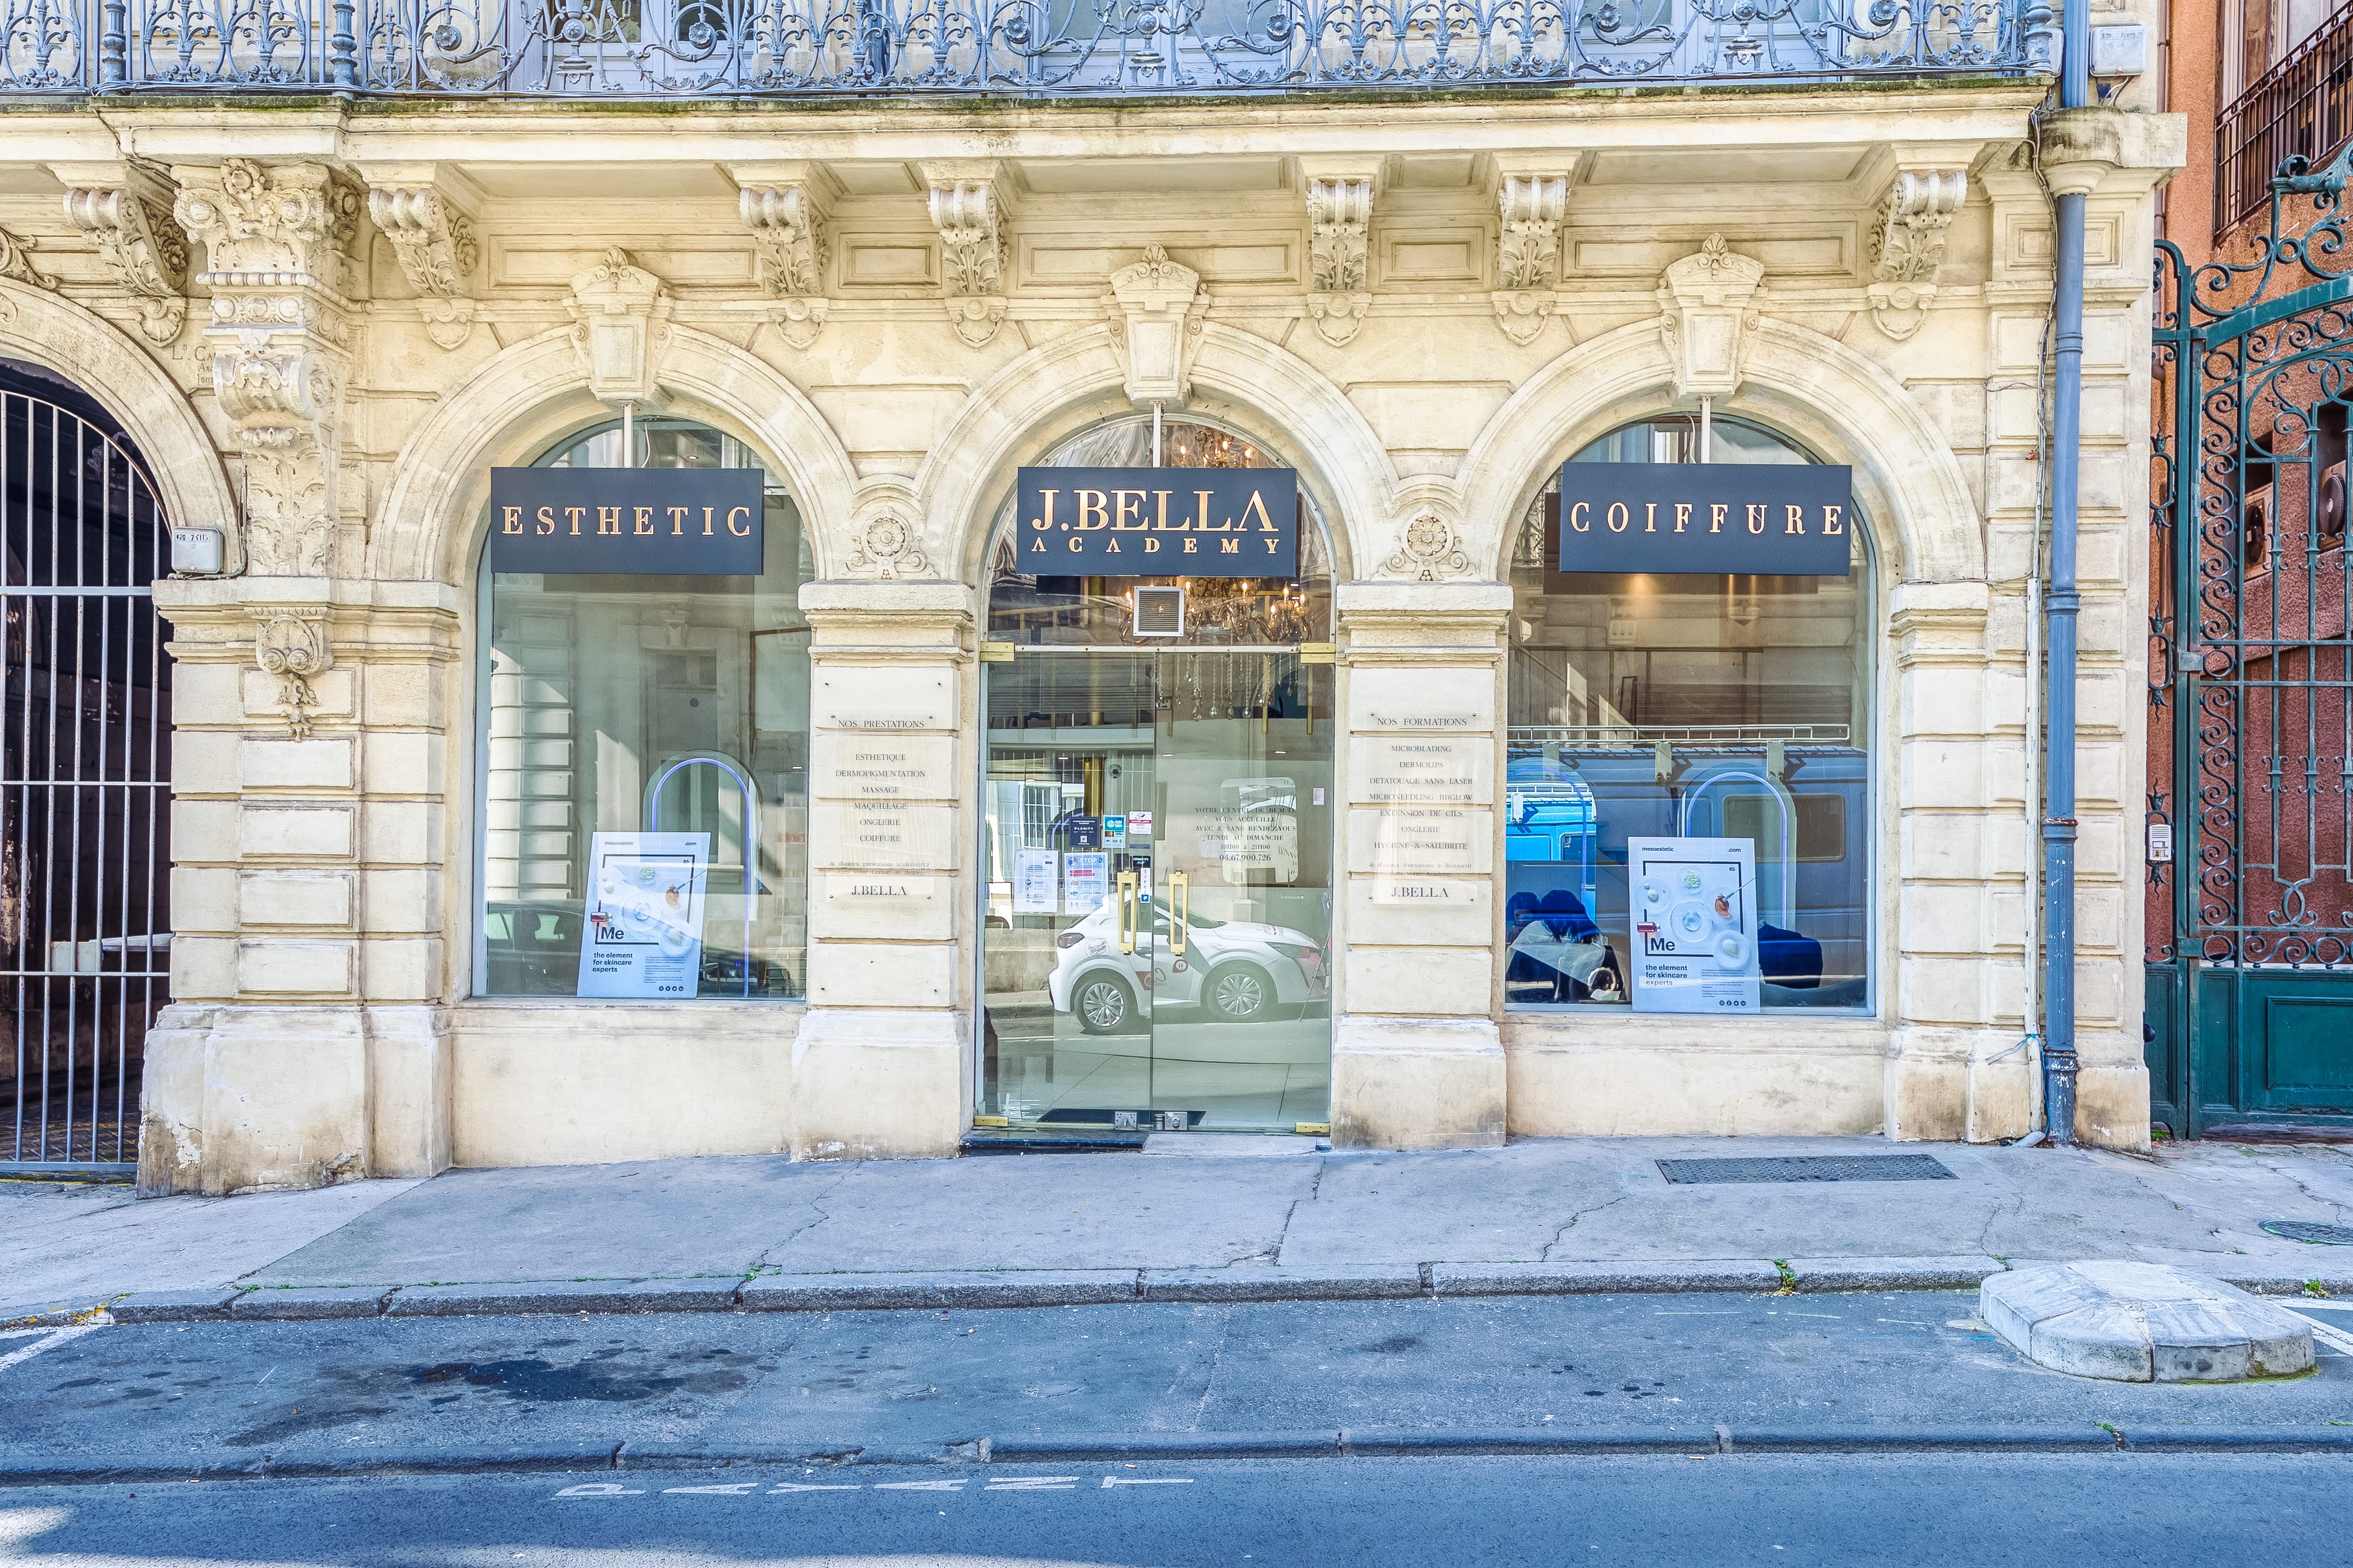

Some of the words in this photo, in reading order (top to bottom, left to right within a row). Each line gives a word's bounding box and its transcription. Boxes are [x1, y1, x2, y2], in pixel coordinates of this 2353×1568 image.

[1032, 489, 1279, 532] J.BELLA
[502, 506, 751, 536] ESTHETIC
[1571, 501, 1843, 535] COIFFURE
[1031, 537, 1279, 554] ACADEMY
[838, 720, 858, 728] NOS
[864, 720, 924, 728] PRESTATIONS
[1378, 718, 1397, 727] NOS
[1403, 718, 1467, 727] FORMATIONS
[854, 803, 907, 811] MAQUILLAGE
[851, 886, 907, 895] J.BELLA
[1391, 887, 1449, 897] J.BELLA
[601, 926, 624, 940] Me
[1650, 938, 1676, 951] Me
